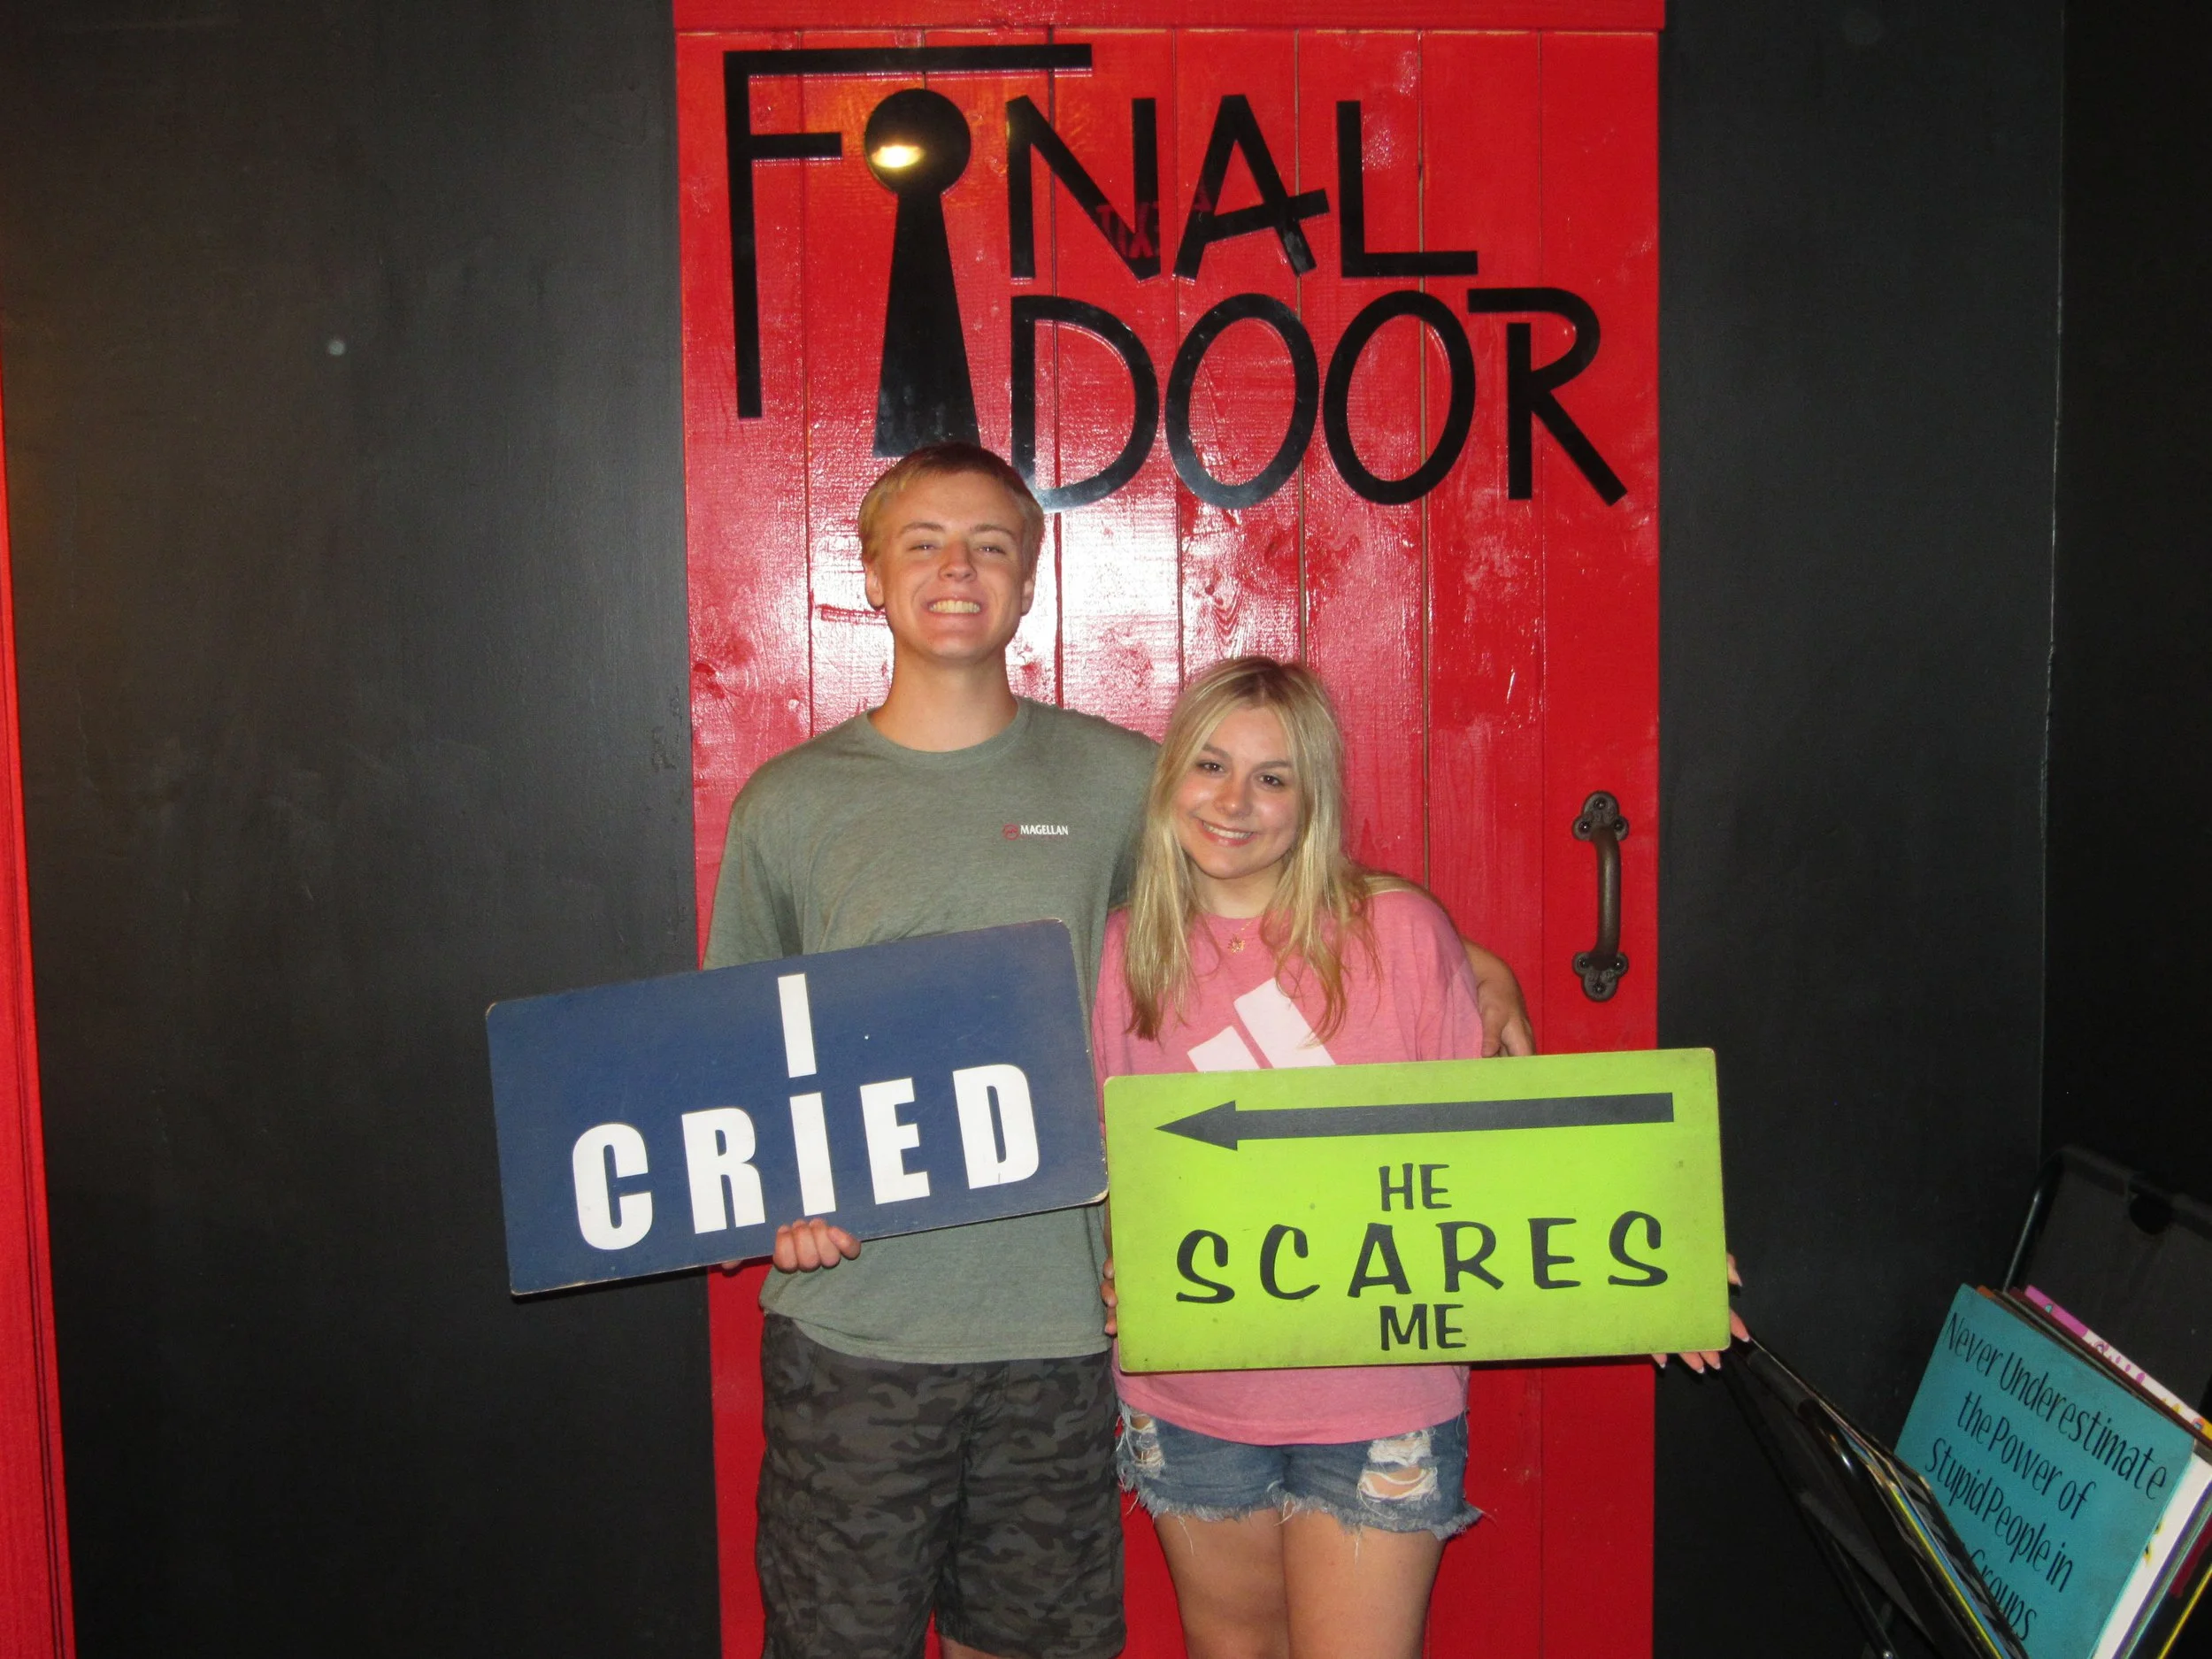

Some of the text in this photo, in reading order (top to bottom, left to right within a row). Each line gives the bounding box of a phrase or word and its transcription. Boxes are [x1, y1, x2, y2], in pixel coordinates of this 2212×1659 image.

[724, 44, 1478, 458] FINAL
[1010, 288, 1627, 512] DOOR
[1020, 825, 1068, 835] MAGELLAN
[778, 973, 817, 1078] I
[572, 1064, 1040, 1250] CRIED
[1379, 1163, 1452, 1211] HE
[1175, 1210, 1668, 1304] SCARES
[1380, 1303, 1467, 1351] ME
[1944, 1312, 2167, 1500] Never Underestimate
[1957, 1390, 2097, 1520] the Power of
[1925, 1437, 2074, 1593] Stupid People in
